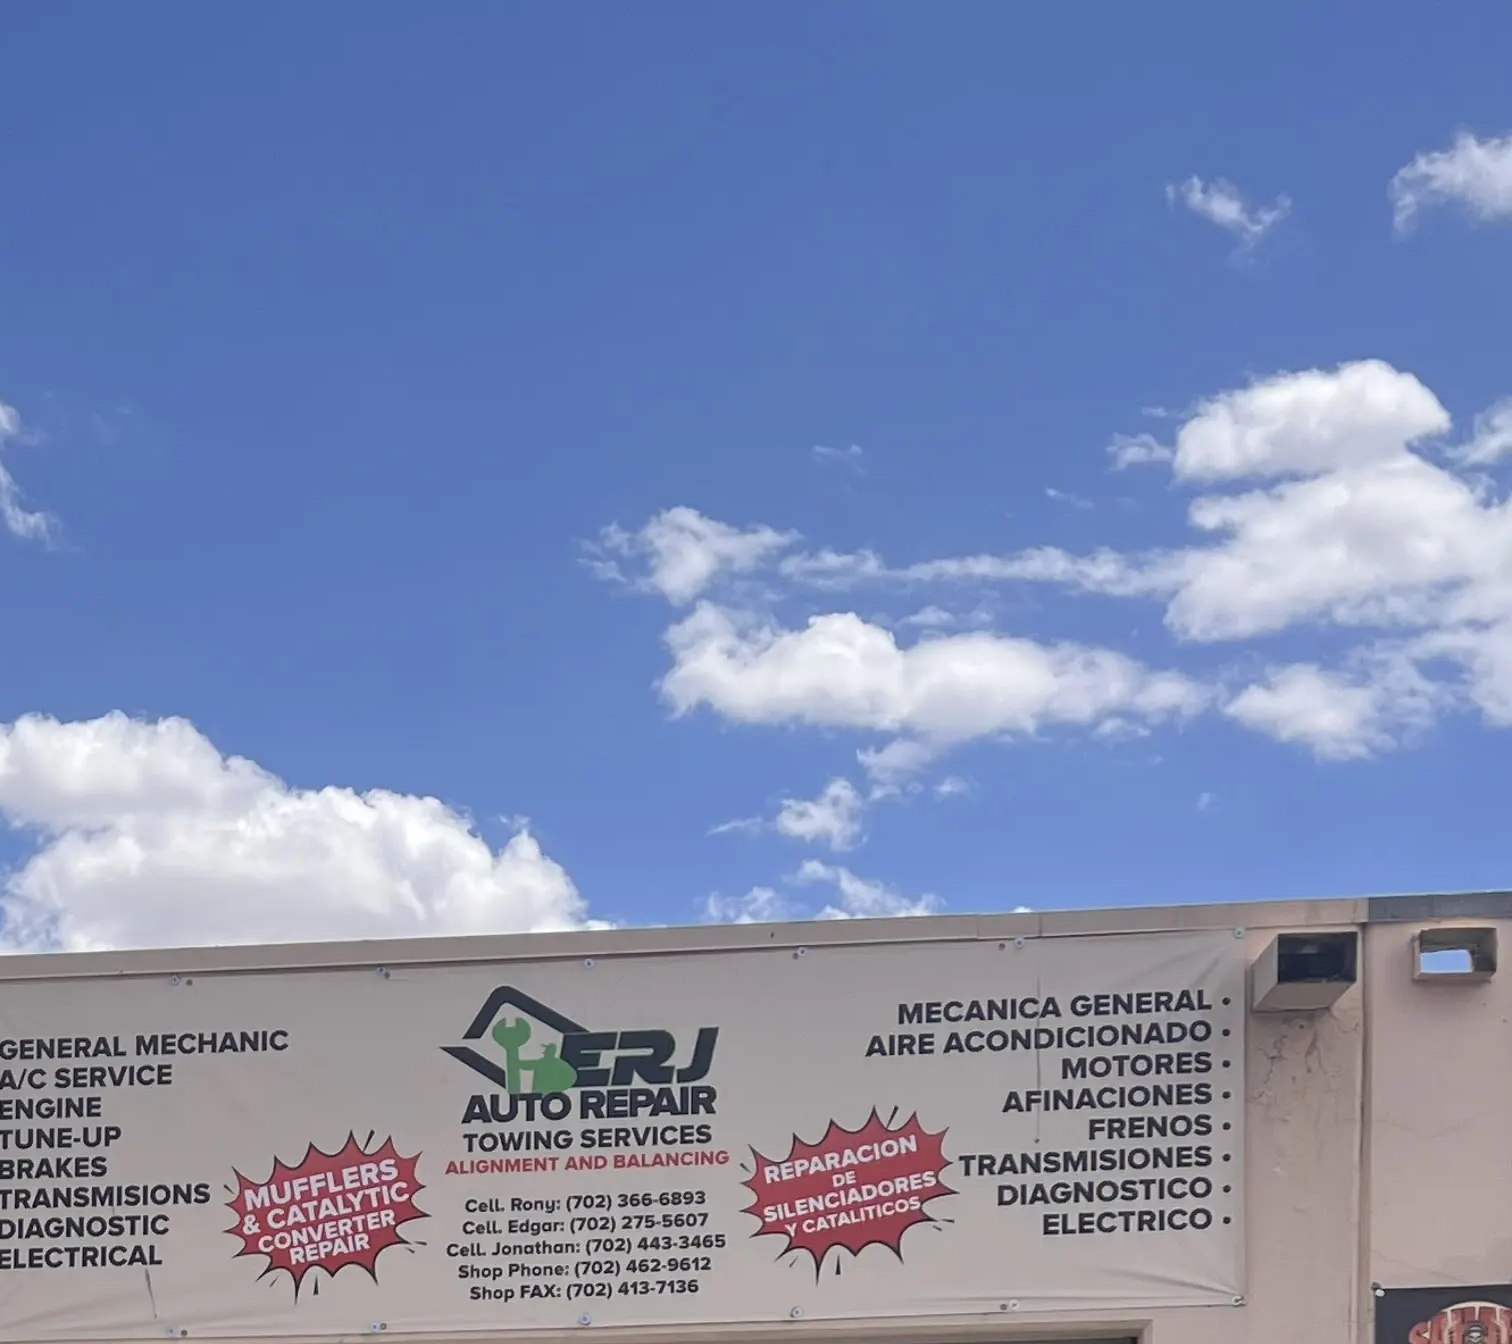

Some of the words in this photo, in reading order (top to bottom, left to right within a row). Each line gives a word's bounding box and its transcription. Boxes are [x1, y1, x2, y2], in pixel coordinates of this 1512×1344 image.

[898, 996, 1061, 1025] MECANICA
[1070, 989, 1212, 1017] GENERAL
[135, 1030, 289, 1056] MECHANIC
[865, 1035, 935, 1057] AIRE
[943, 1020, 1212, 1054] ACONDICIONADO
[562, 1027, 719, 1087] ERJ
[1061, 1051, 1212, 1080] MOTORES
[54, 1065, 172, 1089] SERVICE
[462, 1092, 571, 1124] AUTO
[580, 1086, 717, 1119] REPAIR
[1002, 1083, 1212, 1113] AFINACIONES
[463, 1130, 573, 1153] TOWING
[580, 1124, 712, 1148] SERVICES
[1089, 1114, 1212, 1140] FRENOS
[445, 1156, 559, 1175] ALIGNMENT
[565, 1154, 607, 1171] AND
[614, 1150, 730, 1169] BALANCING
[764, 1134, 917, 1184] REPARACION
[959, 1145, 1212, 1176] TRANSMISIONES
[244, 1159, 398, 1212] MUFFLERS
[832, 1170, 857, 1187] DE
[997, 1176, 1212, 1206] DIAGNOSTICO
[242, 1214, 261, 1235] &
[267, 1181, 409, 1230] CATALYTIC
[465, 1198, 505, 1213] Cell.
[510, 1197, 561, 1216] Rony:
[566, 1193, 611, 1213] (702)
[617, 1191, 706, 1208] 366-6893
[764, 1171, 937, 1223] SILENCIADORES
[462, 1219, 502, 1235] Cell.
[508, 1218, 565, 1238] Edgar:
[570, 1215, 616, 1235] (702)
[622, 1212, 709, 1230] 275-5607
[785, 1222, 798, 1238] Y
[802, 1195, 921, 1234] CATALITICOS
[1042, 1208, 1212, 1235] ELECTRICO
[259, 1210, 395, 1254] CONVERTER
[446, 1242, 487, 1257] Cell.
[492, 1238, 581, 1256] Jonathan:
[585, 1237, 632, 1256] (702)
[637, 1234, 726, 1250] 443-3465
[289, 1234, 369, 1265] REPAIR
[458, 1264, 503, 1283] Shop
[508, 1261, 569, 1279] Phone:
[574, 1259, 620, 1278] (702)
[626, 1256, 711, 1273] 462-9612
[470, 1286, 515, 1303] Shop
[521, 1283, 562, 1300] FAX:
[566, 1281, 612, 1300] (702)
[618, 1279, 699, 1296] 413-7136
